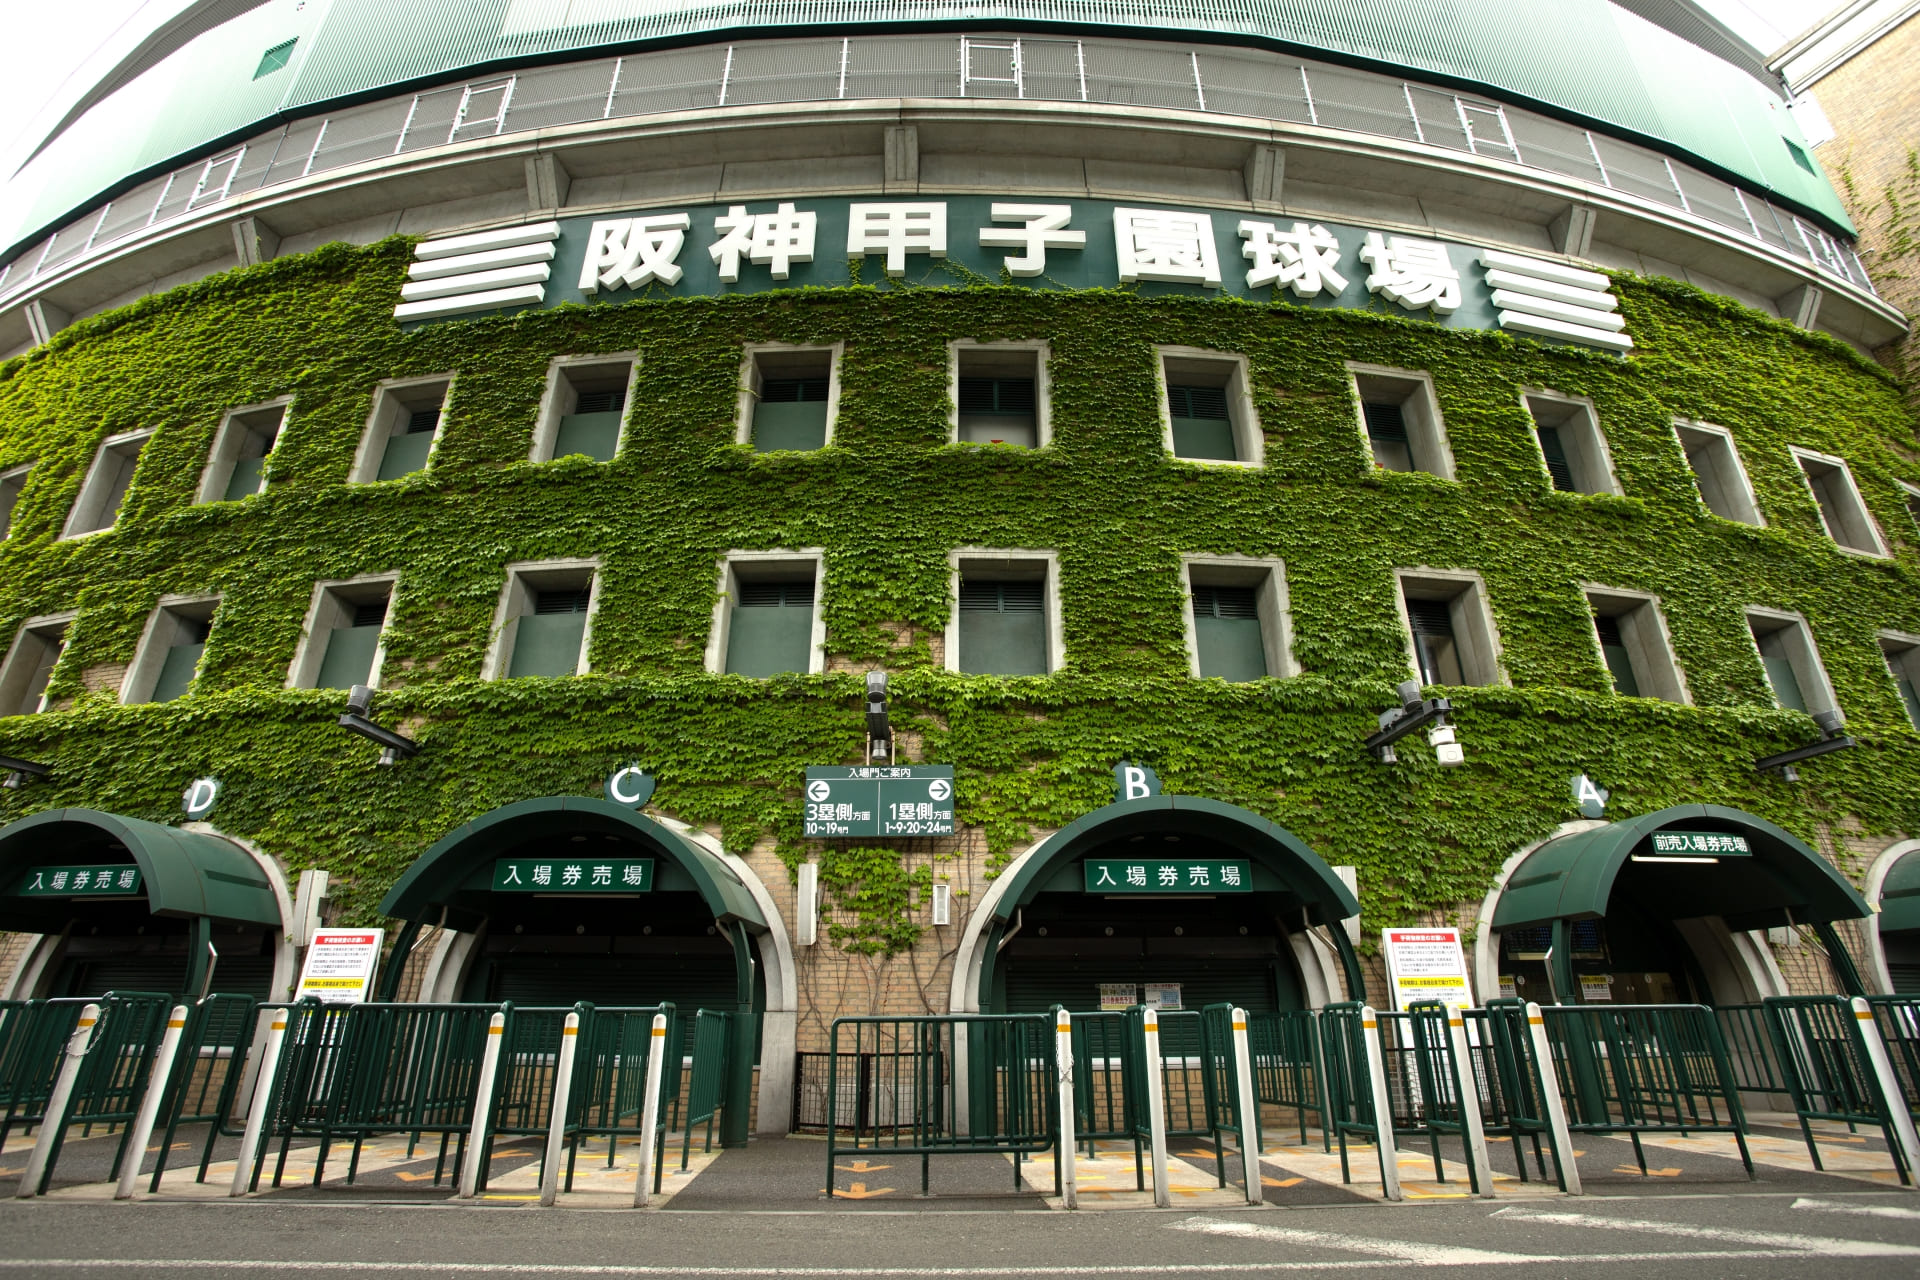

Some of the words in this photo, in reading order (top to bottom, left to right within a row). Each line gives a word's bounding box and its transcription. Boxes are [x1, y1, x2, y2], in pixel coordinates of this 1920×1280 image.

[578, 202, 1462, 316] 阪神甲子園球場
[848, 767, 911, 779] 入場門ご案内
[1124, 766, 1151, 801] B
[610, 766, 642, 803] C
[1577, 774, 1605, 808] A
[186, 779, 217, 813] D
[806, 803, 871, 821] 3塁側方面
[889, 803, 952, 821] 1塁側方面
[1655, 834, 1749, 853] 前売入場券売場
[28, 870, 136, 890] 入場券売場
[503, 864, 643, 886] 入場券売場
[1096, 865, 1241, 887] 入場券売場
